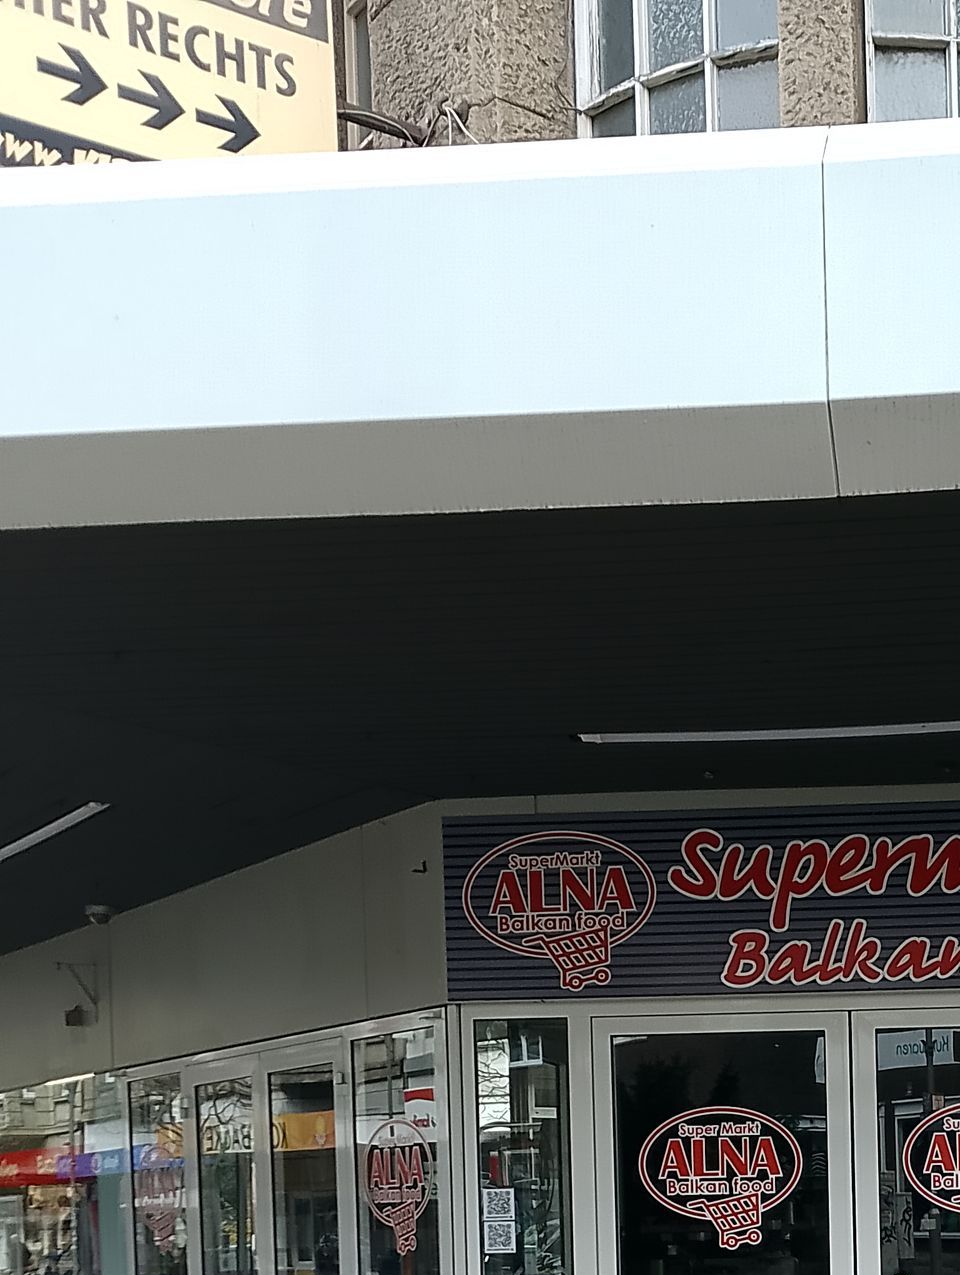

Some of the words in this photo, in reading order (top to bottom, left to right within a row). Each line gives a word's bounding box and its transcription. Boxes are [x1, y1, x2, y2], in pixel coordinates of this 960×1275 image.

[127, 0, 297, 98] RECHTS
[488, 865, 637, 915] ALNA
[497, 913, 572, 934] Balkan
[575, 910, 627, 931] food
[678, 1122, 719, 1138] Super
[719, 1121, 761, 1136] Markt
[370, 1145, 425, 1189] ALNA
[658, 1136, 784, 1179] ALNA
[666, 1178, 729, 1196] Balkan
[732, 1176, 776, 1194] food
